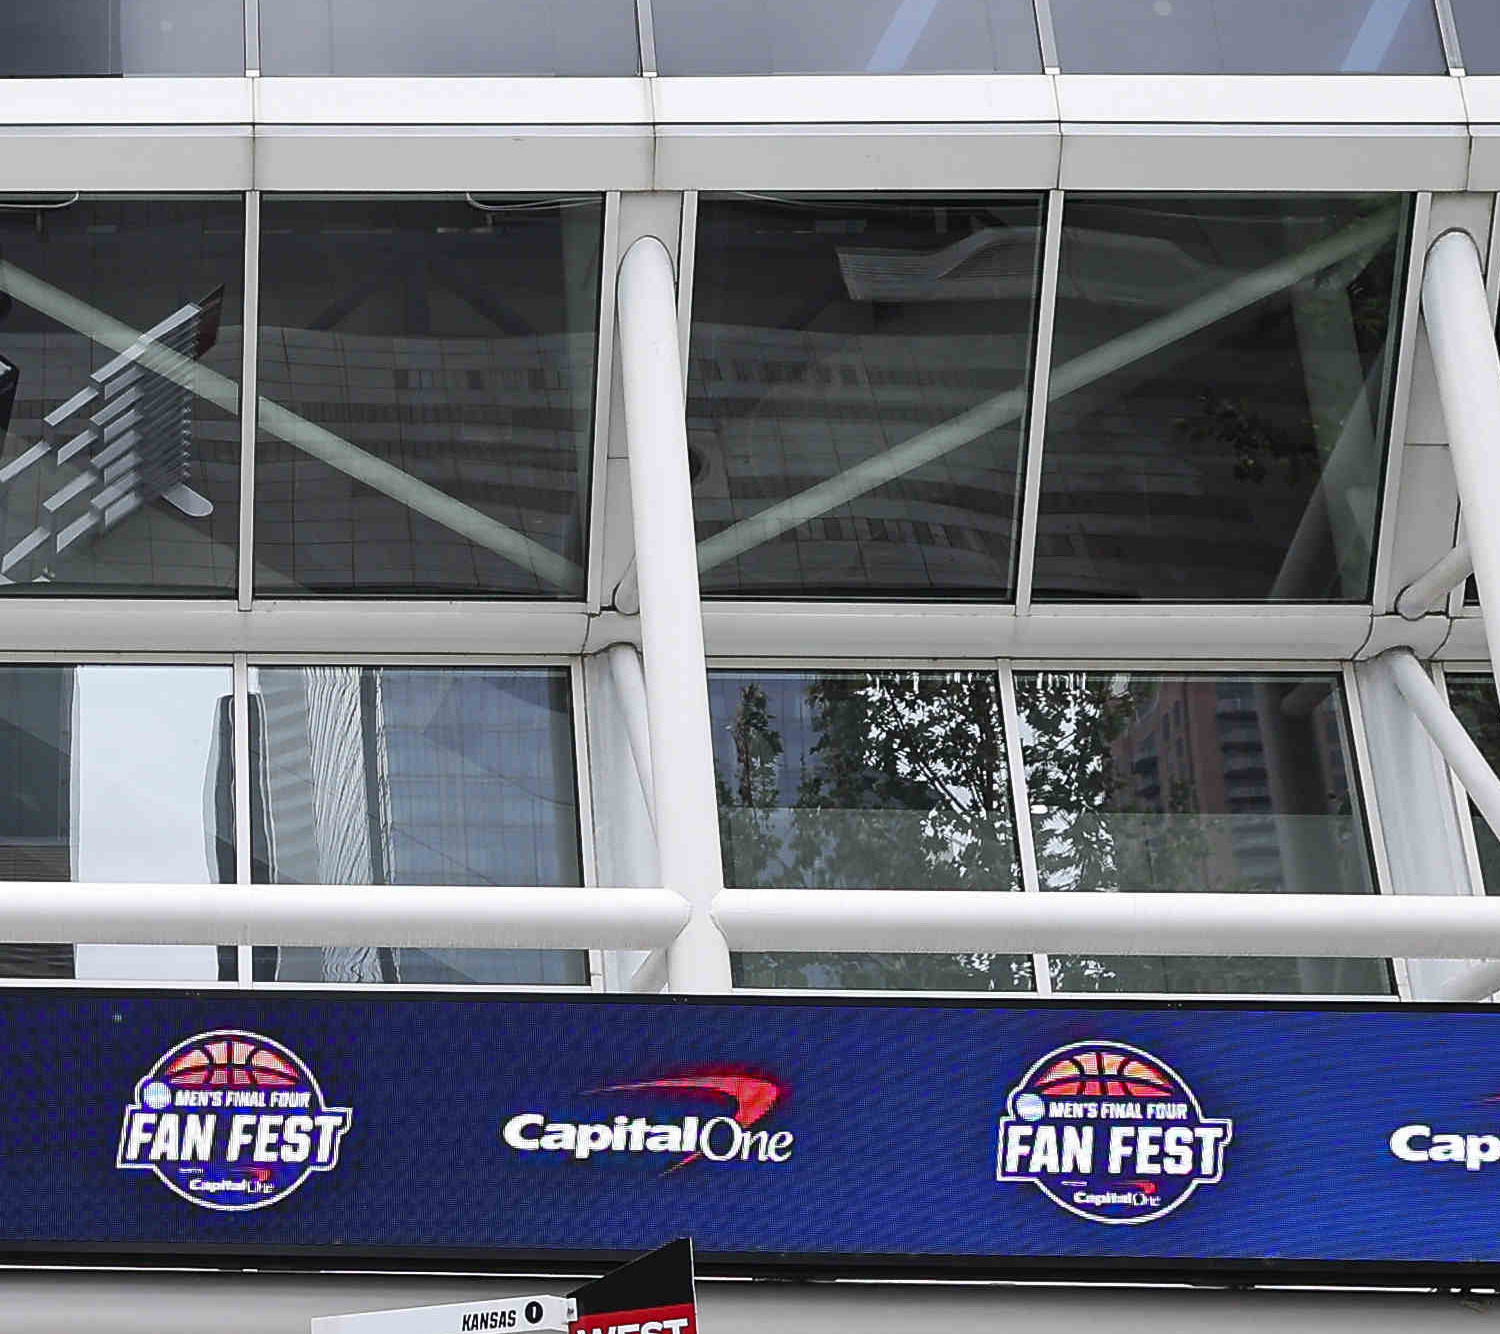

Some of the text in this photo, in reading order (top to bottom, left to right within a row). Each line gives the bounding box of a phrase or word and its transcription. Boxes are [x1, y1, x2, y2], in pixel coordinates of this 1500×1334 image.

[1049, 1102, 1187, 1119] MEN'S FINAL FOUR
[126, 1113, 343, 1162] FAN FEST
[1005, 1125, 1223, 1175] FAN FEST
[462, 1310, 516, 1334] KANSAS
